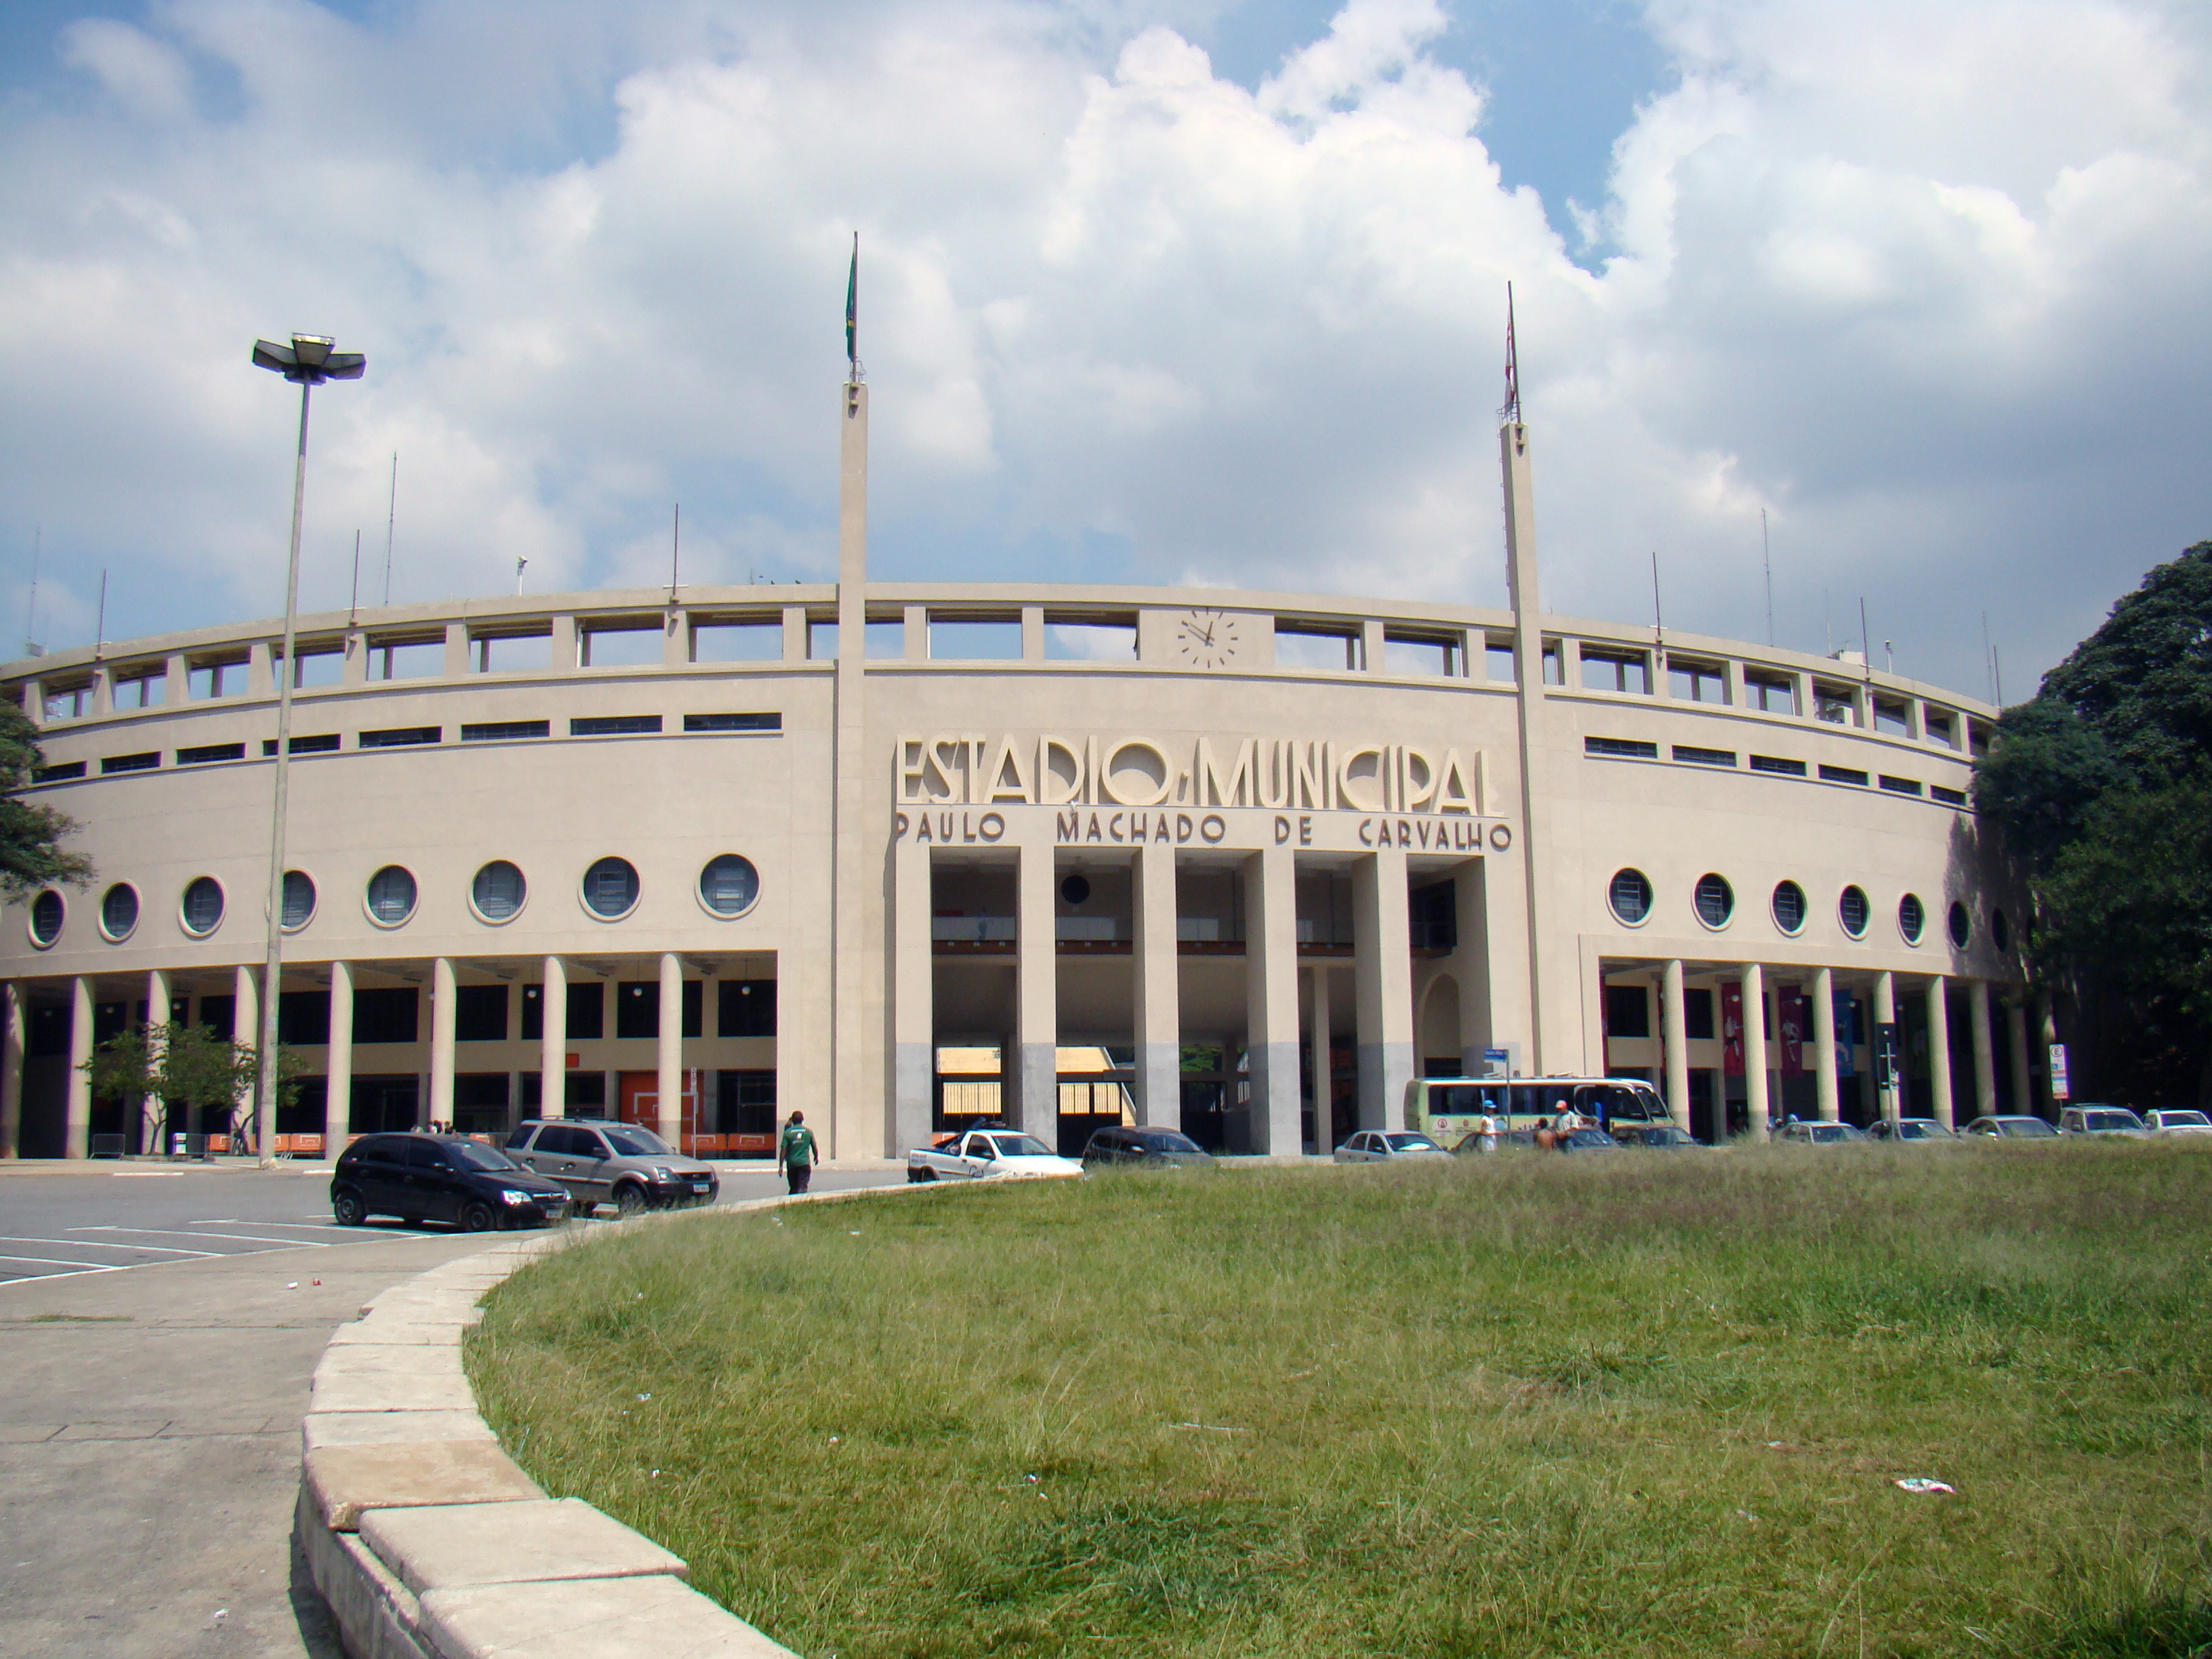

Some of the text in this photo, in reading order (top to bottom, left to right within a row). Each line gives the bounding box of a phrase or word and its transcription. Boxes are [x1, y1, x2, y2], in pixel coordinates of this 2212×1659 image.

[896, 732, 1504, 817] ESTADIO MUNICIPAL
[896, 811, 1511, 852] PAULO MACHADO DE CARVALHO
